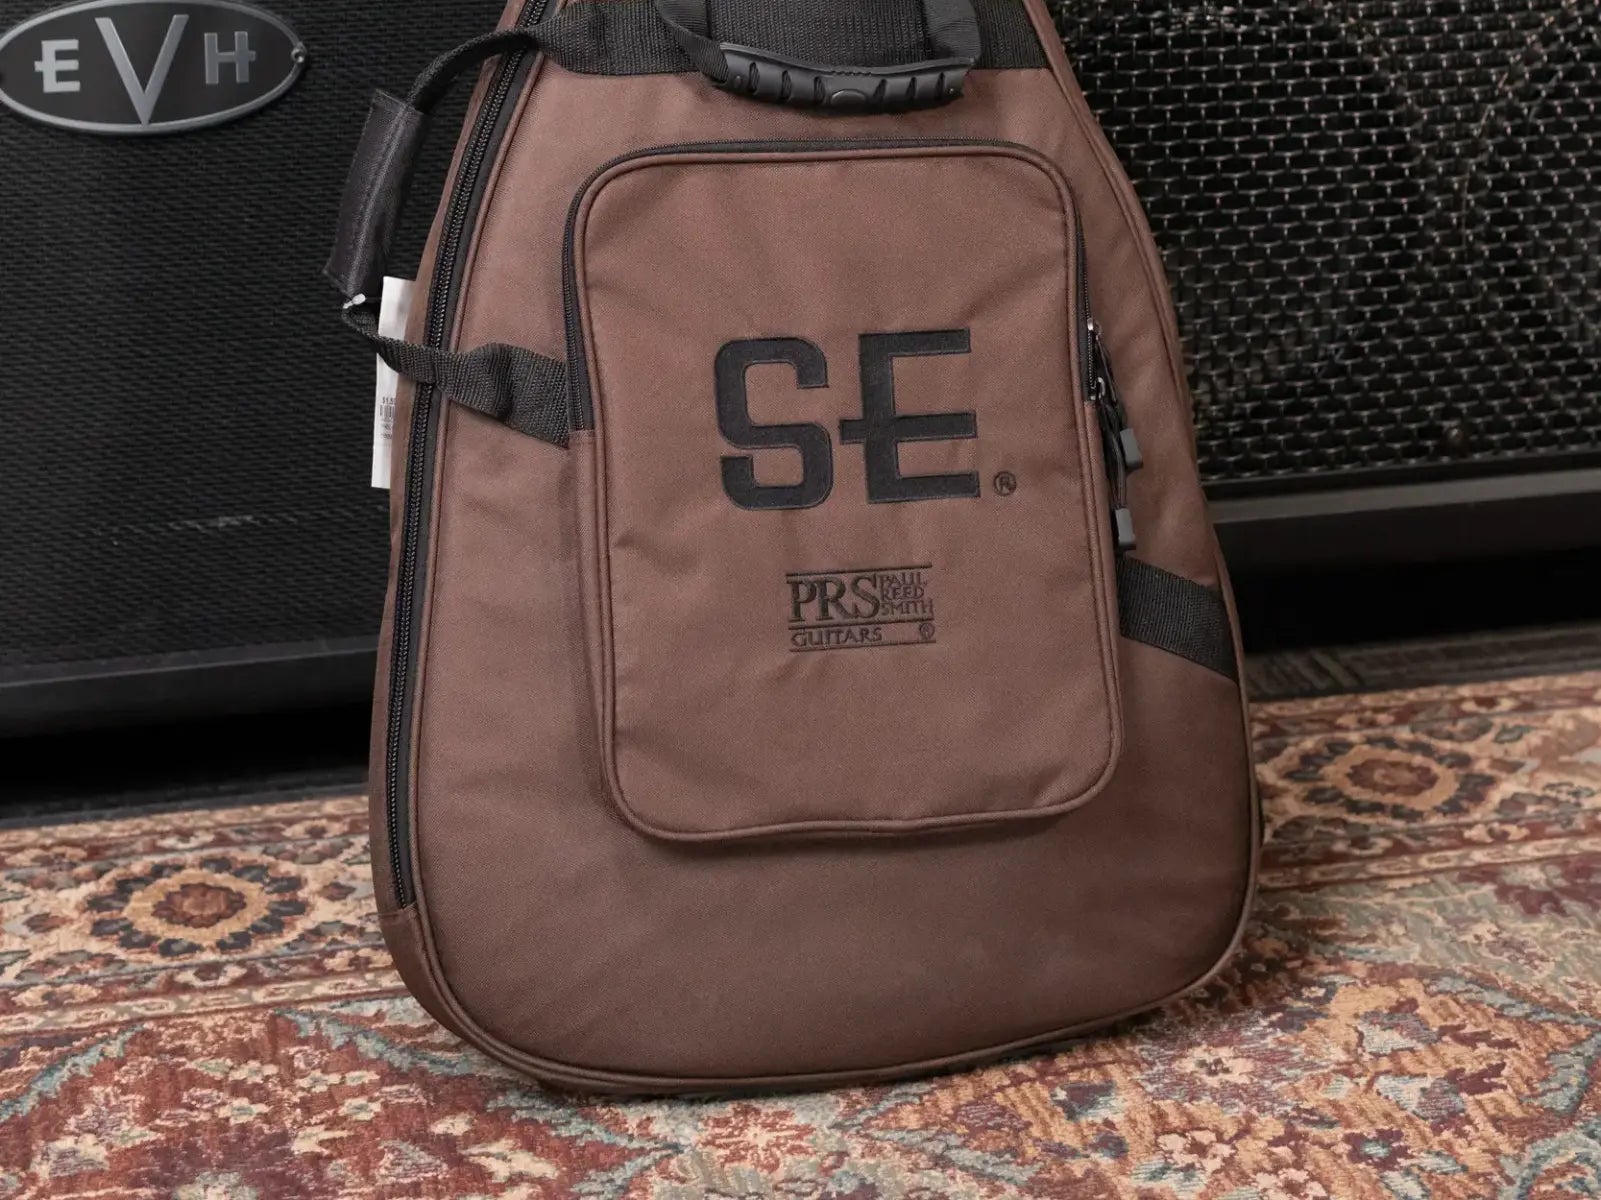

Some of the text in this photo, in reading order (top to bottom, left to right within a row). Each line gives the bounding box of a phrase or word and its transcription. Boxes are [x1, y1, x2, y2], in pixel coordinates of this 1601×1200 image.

[34, 14, 257, 125] EVH
[714, 327, 981, 510] SE
[786, 573, 881, 623] PRS
[880, 586, 925, 601] REED
[880, 599, 934, 617] SMITH
[791, 628, 882, 647] GUITARS
